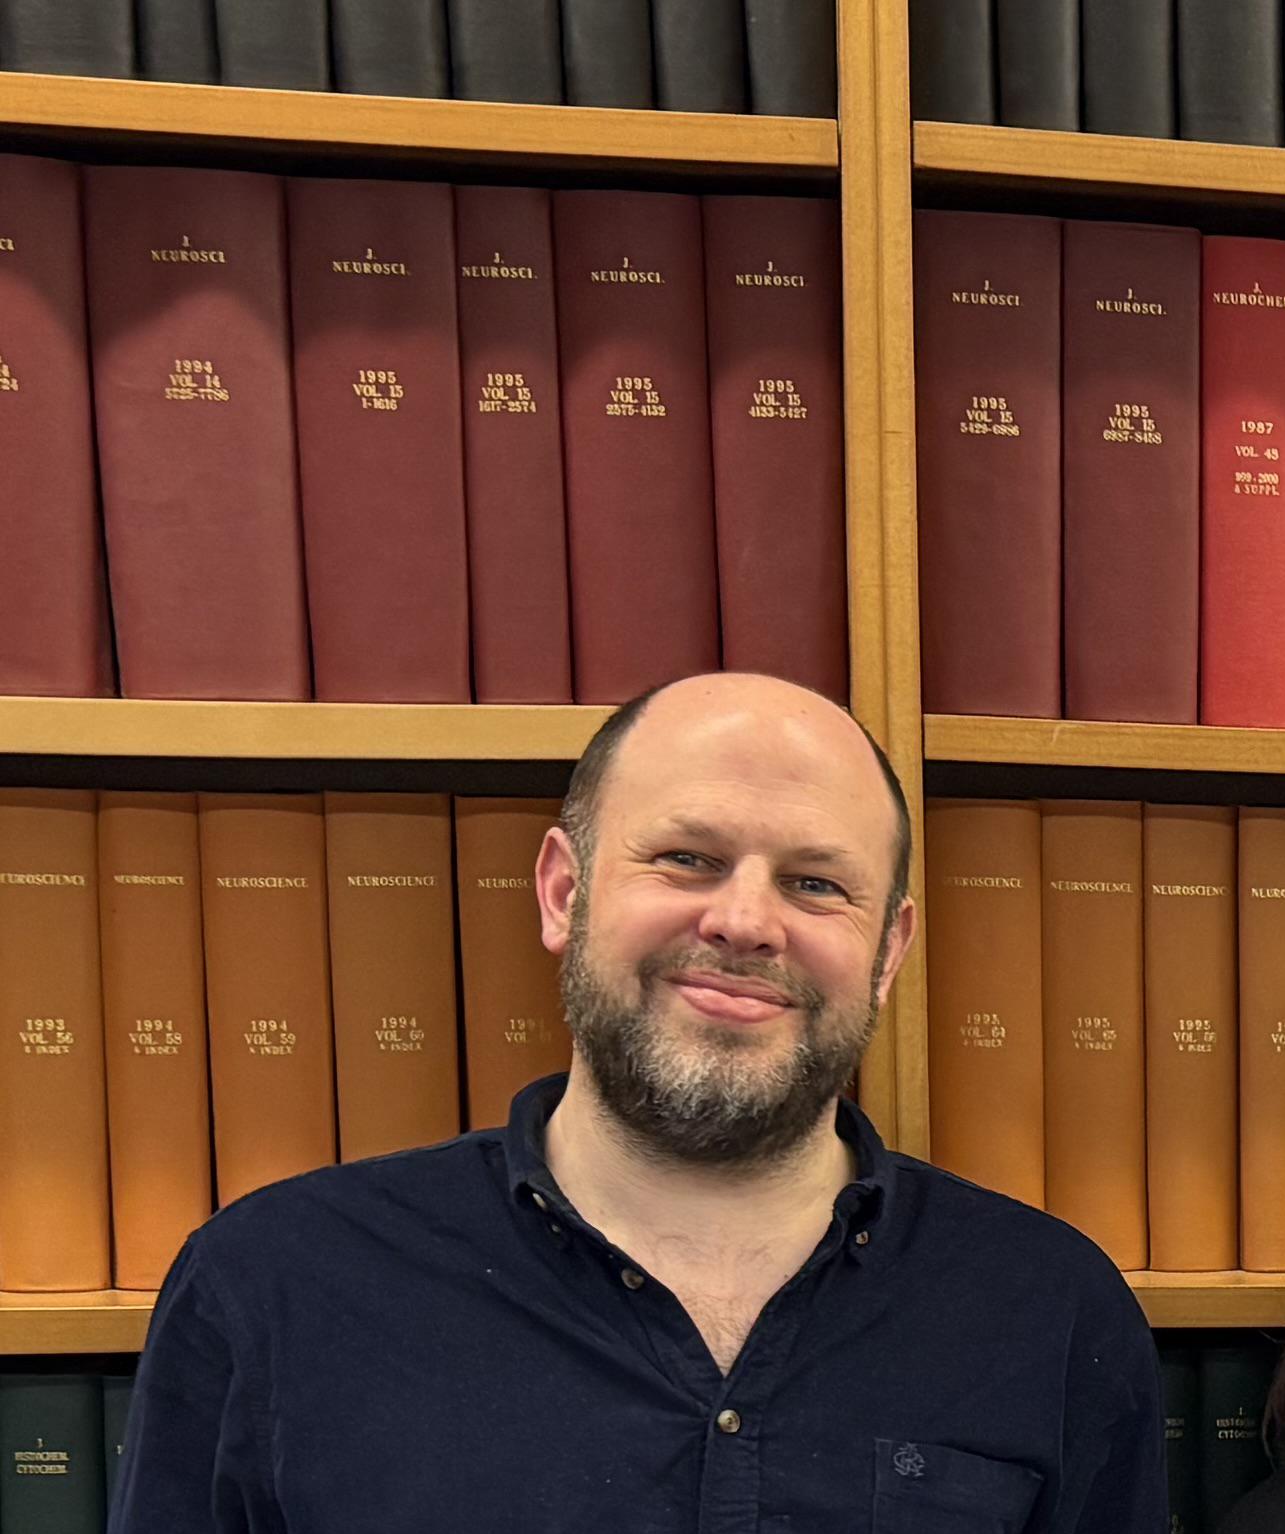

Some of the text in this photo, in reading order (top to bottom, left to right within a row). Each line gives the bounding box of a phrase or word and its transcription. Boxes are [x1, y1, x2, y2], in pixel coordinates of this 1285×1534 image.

[175, 360, 212, 373] 1994
[359, 370, 396, 386] 1995
[488, 374, 523, 386] 1995
[617, 377, 652, 390] 1995
[390, 385, 403, 397] 15
[759, 380, 794, 392] 1995
[517, 387, 530, 400] 15
[646, 391, 659, 403] 15
[788, 394, 800, 405] 15
[972, 397, 1006, 410] 1995
[1000, 411, 1013, 423] 15
[1115, 404, 1149, 419] 1995
[1143, 419, 1155, 431] 15
[1242, 421, 1273, 433] 1987
[217, 877, 308, 888] NEUROSCIENCE
[347, 876, 435, 886] NEUROSCIENCE
[27, 1019, 64, 1030] 1993
[136, 1020, 172, 1031] 1994
[251, 1020, 287, 1031] 1994
[382, 1016, 416, 1028] 1994
[280, 1033, 295, 1044] 59
[409, 1030, 424, 1041] 60
